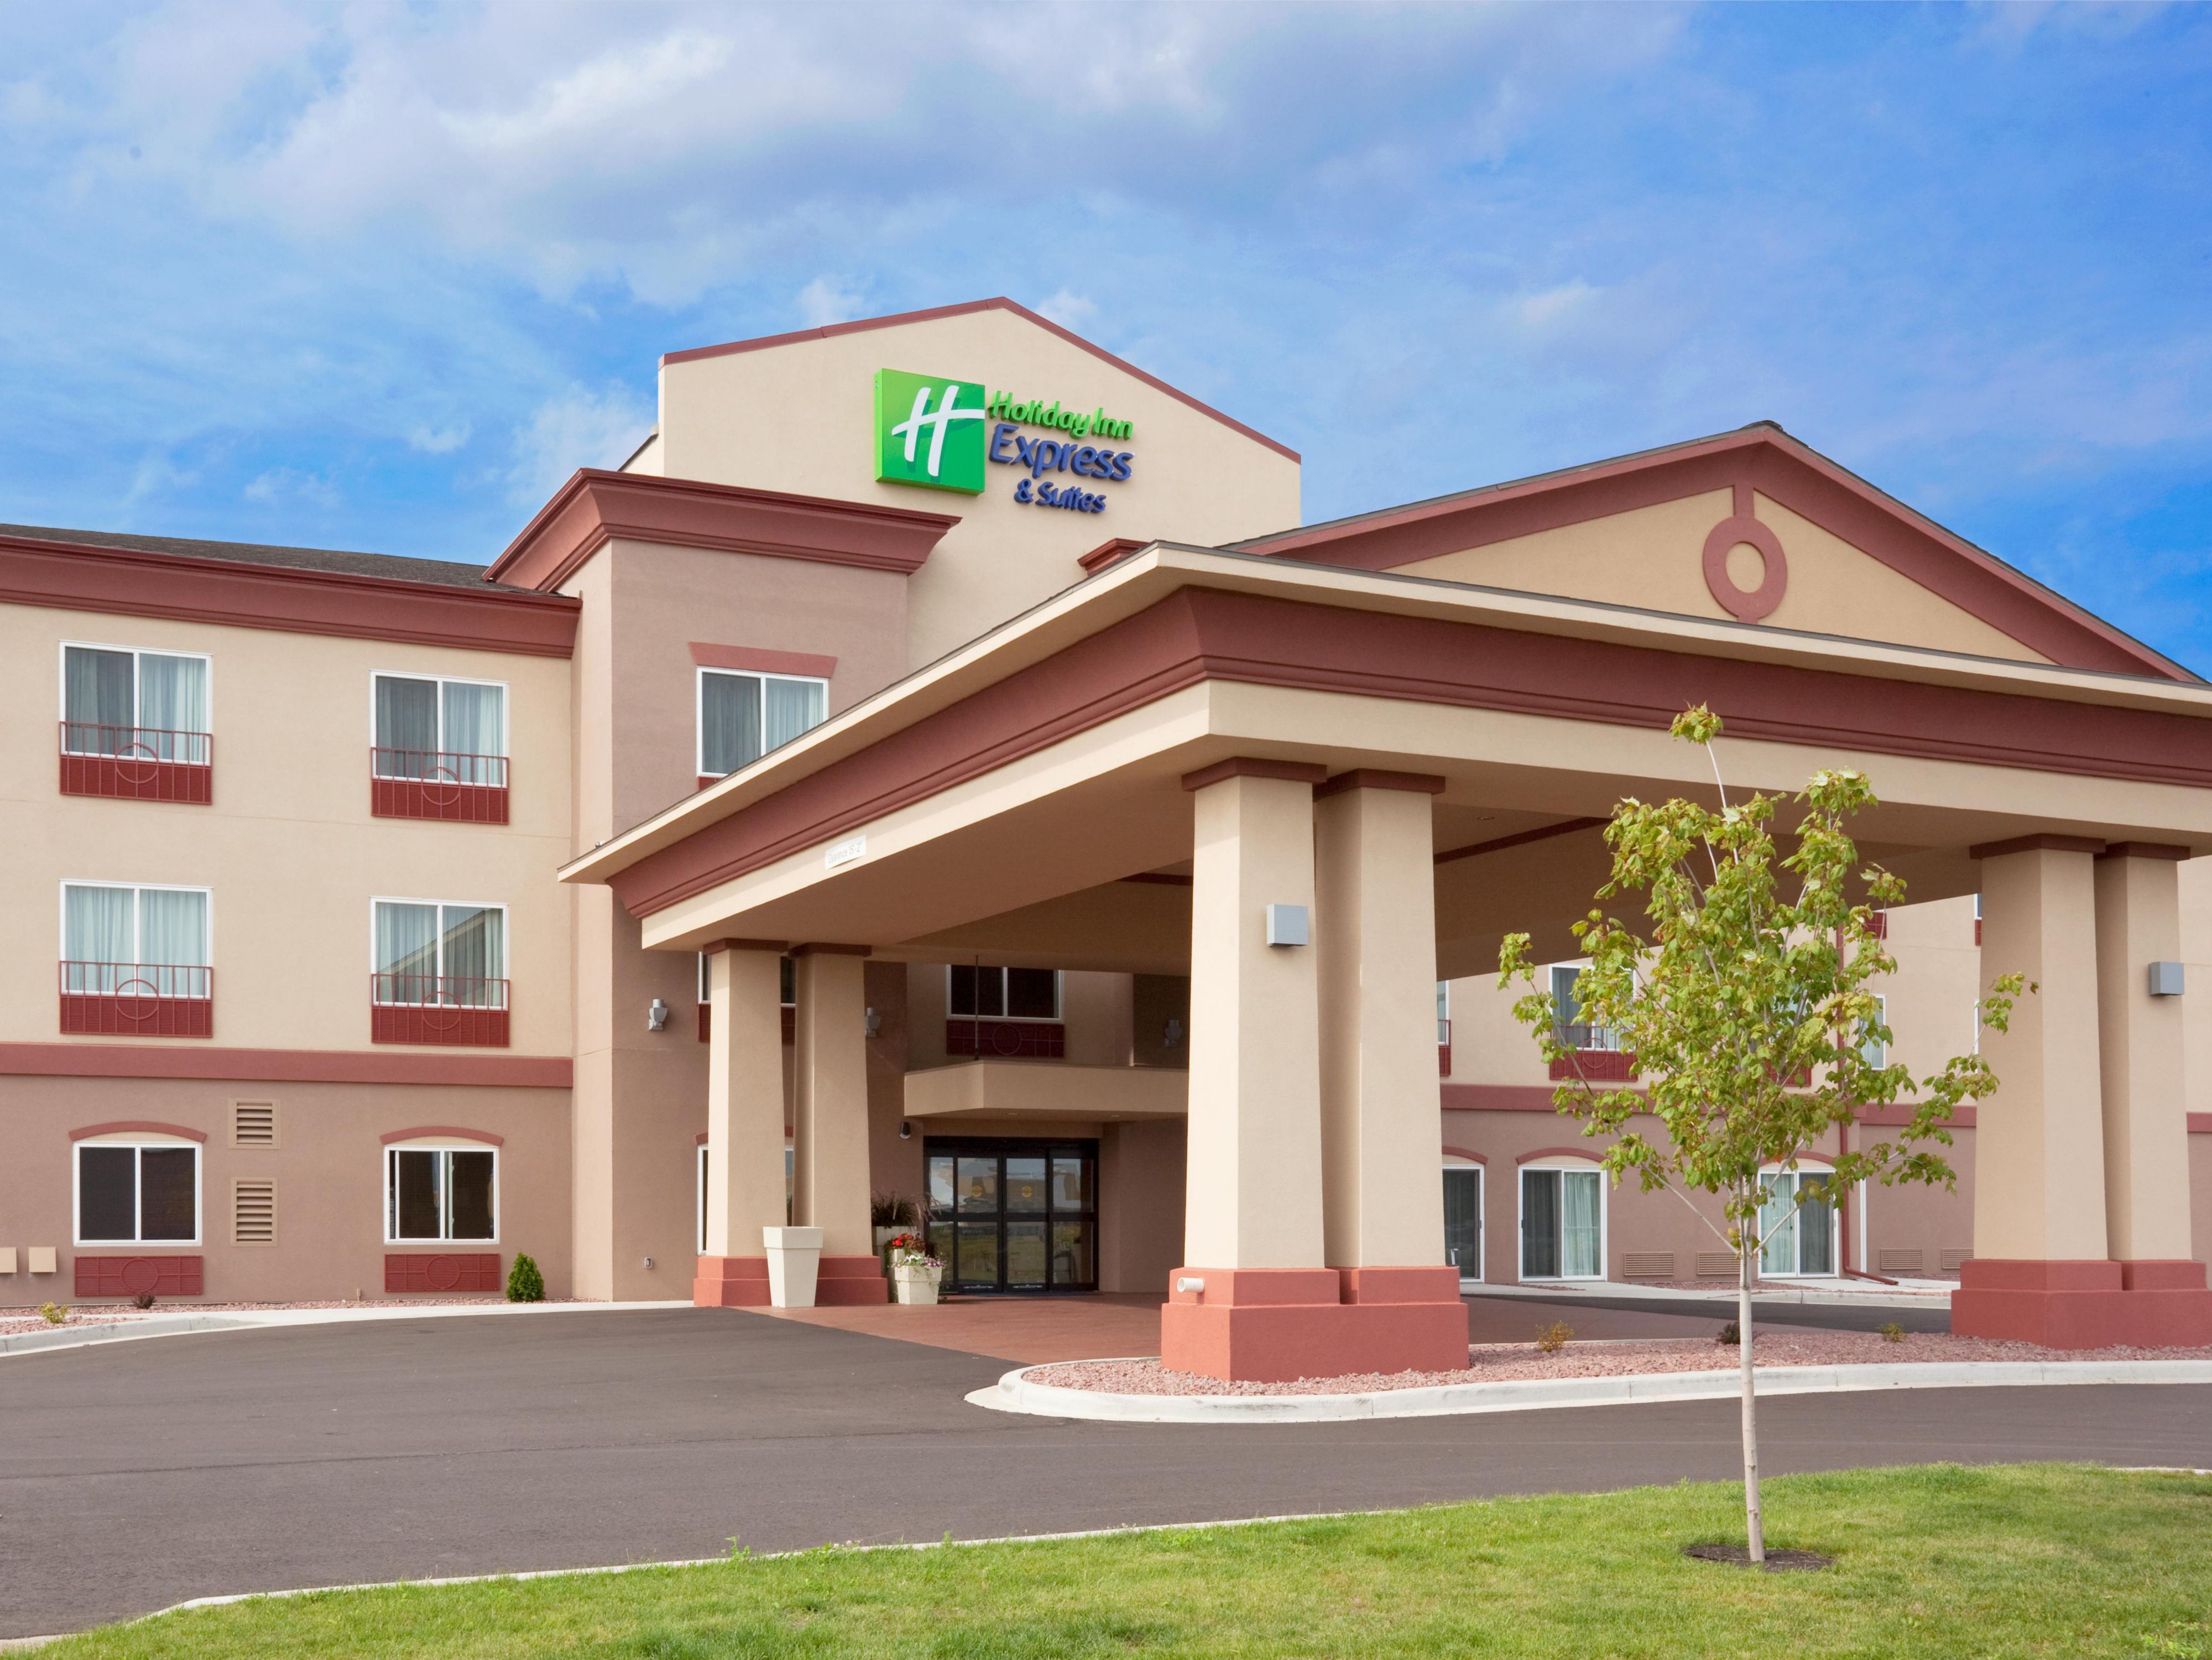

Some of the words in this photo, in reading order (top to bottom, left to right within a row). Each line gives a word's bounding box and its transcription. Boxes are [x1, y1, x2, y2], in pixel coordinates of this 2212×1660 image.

[988, 391, 1091, 439] Holiday
[1092, 407, 1134, 440] Inn
[989, 423, 1135, 481] Express
[1014, 478, 1034, 504] &
[1036, 481, 1107, 513] Suites
